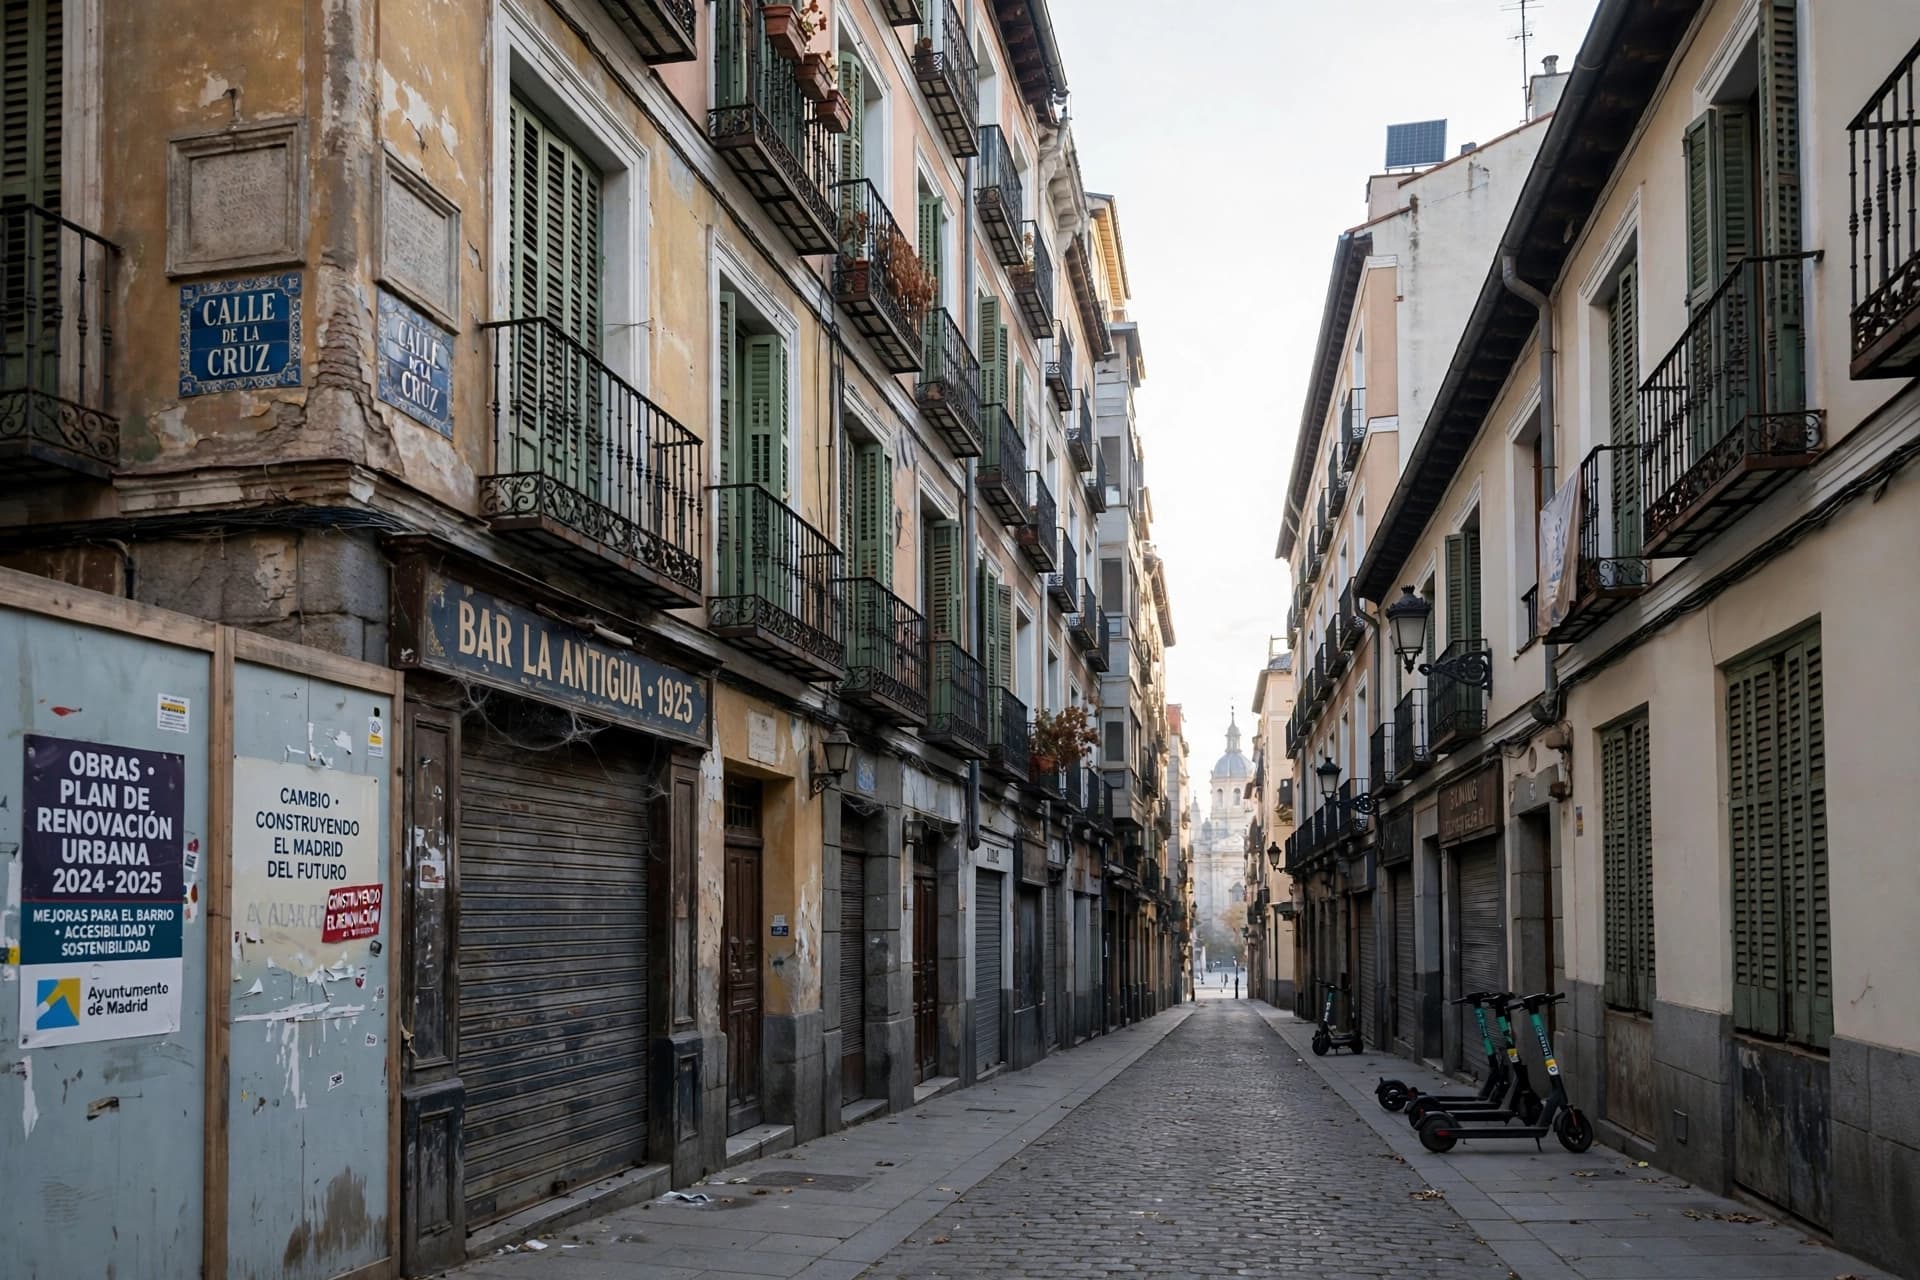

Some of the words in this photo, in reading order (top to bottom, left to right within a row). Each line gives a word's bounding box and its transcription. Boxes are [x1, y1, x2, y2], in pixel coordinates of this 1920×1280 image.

[203, 293, 275, 326] CALLE
[222, 328, 238, 344] DE
[244, 325, 260, 342] LA
[398, 321, 441, 370] CALLE
[207, 344, 270, 376] CRUZ
[401, 371, 439, 413] CRUZ
[458, 600, 512, 668] BAR
[523, 624, 553, 681] LA
[559, 639, 643, 709] ANTIGUA
[657, 675, 693, 724] 1925
[69, 750, 141, 782] OBRAS
[60, 778, 117, 809] PLAN
[124, 785, 150, 811] DE
[280, 787, 331, 809] CAMBIO
[37, 807, 173, 840] RENOVACIÓN
[256, 811, 360, 836] CONSTRUYENDO
[62, 838, 150, 866] URBANA
[274, 837, 289, 855] EL
[293, 838, 343, 857] MADRID
[52, 868, 162, 895] 2024-2025
[267, 860, 293, 879] DEL
[297, 862, 347, 881] FUTURO
[33, 909, 88, 923] MEJORAS
[91, 909, 118, 922] PARA
[121, 909, 134, 922] EL
[136, 909, 175, 921] BARRIO
[64, 924, 146, 939] ACCESIBILIDAD
[147, 924, 156, 937] Y
[61, 940, 151, 956] SOSTENIBILIDAD
[87, 1003, 104, 1016] de
[106, 998, 148, 1015] Madrid
